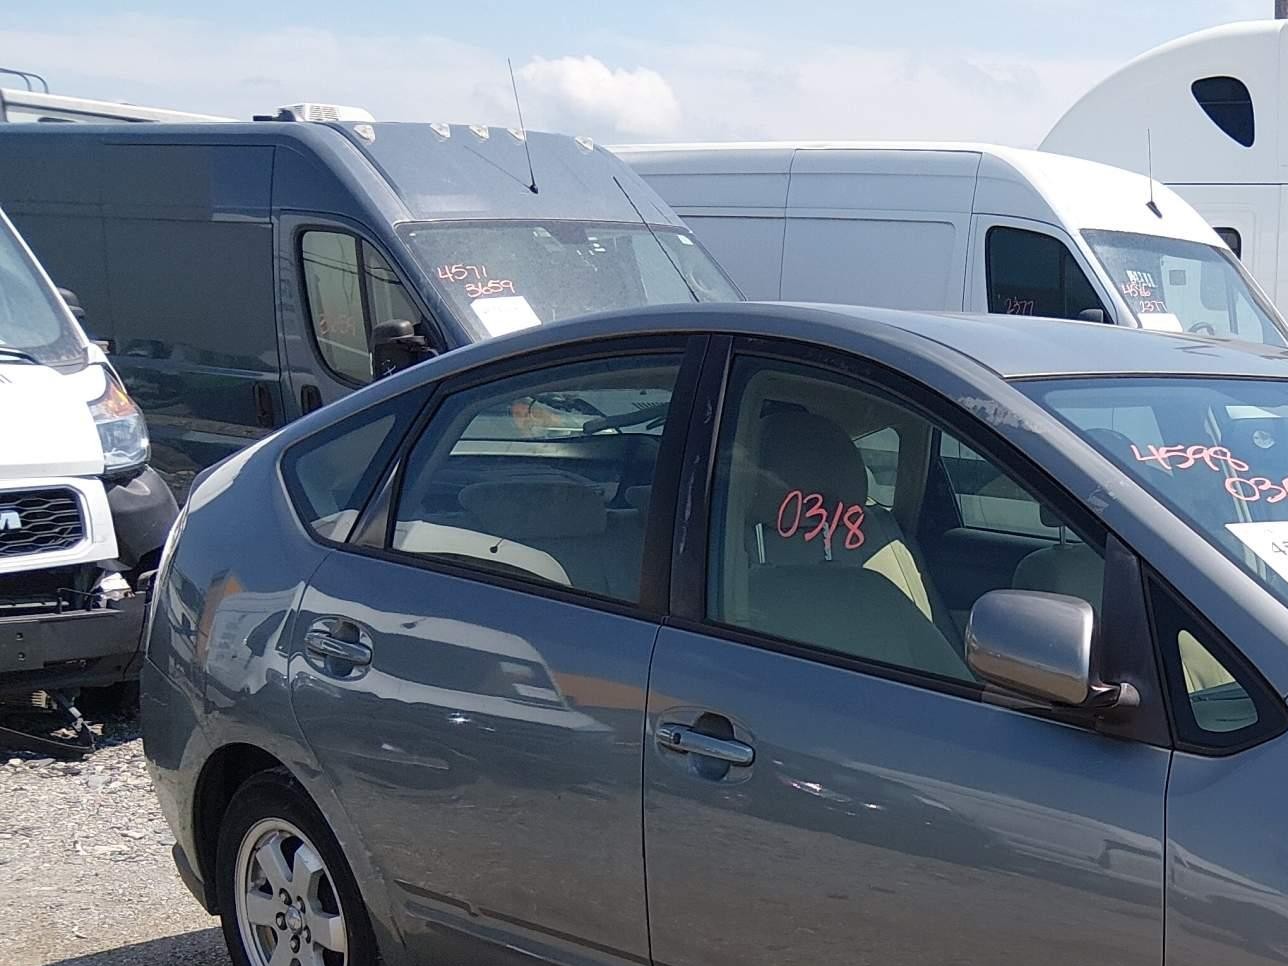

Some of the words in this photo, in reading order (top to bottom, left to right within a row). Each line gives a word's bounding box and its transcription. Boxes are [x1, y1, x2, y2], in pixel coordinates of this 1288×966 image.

[436, 264, 487, 282] 4571
[465, 279, 516, 298] 3659
[1139, 300, 1168, 313] 2377
[1130, 444, 1249, 472] 4598
[777, 489, 866, 551] 0318
